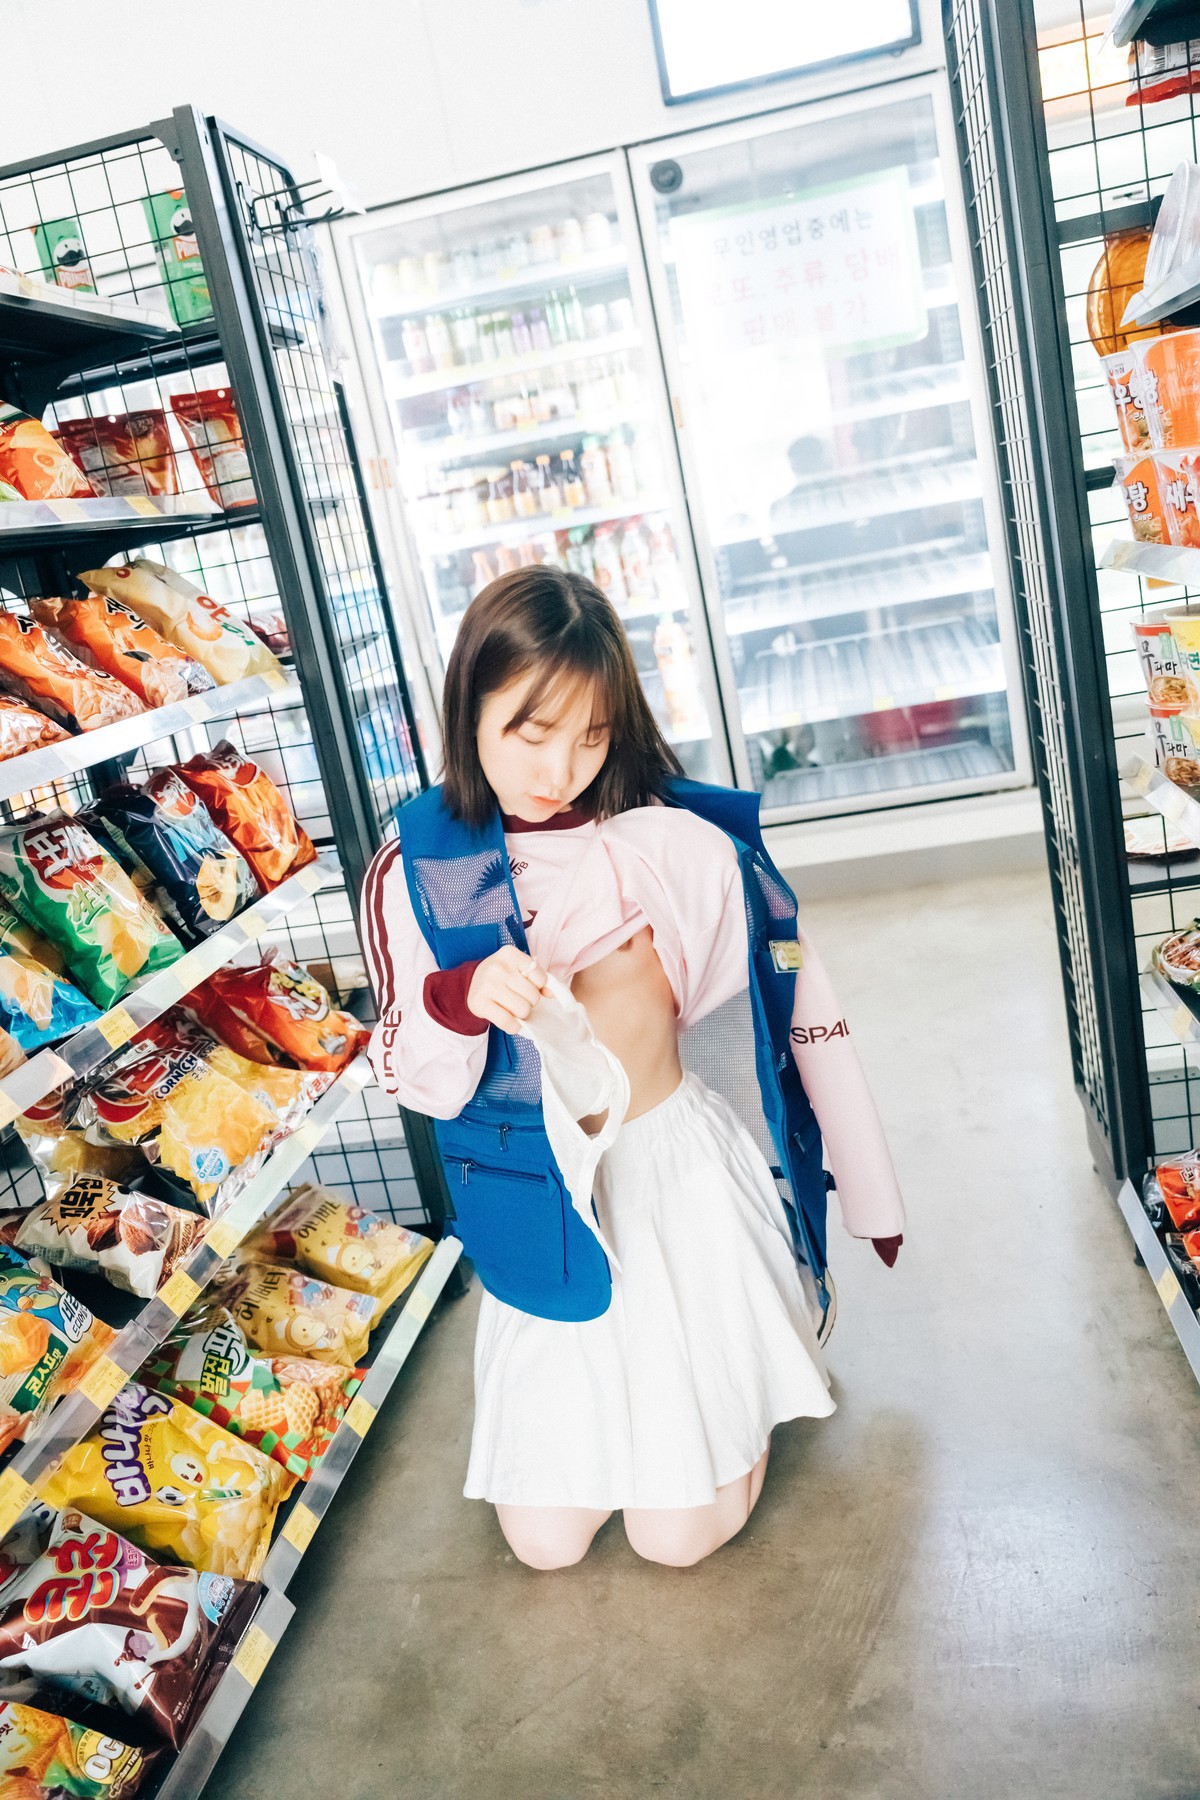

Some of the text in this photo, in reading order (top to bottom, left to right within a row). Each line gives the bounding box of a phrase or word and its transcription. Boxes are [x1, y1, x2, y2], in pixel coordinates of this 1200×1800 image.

[713, 209, 873, 259] 무인영업중에는
[236, 1269, 287, 1321] 허니버터
[200, 1354, 232, 1397] 벌집
